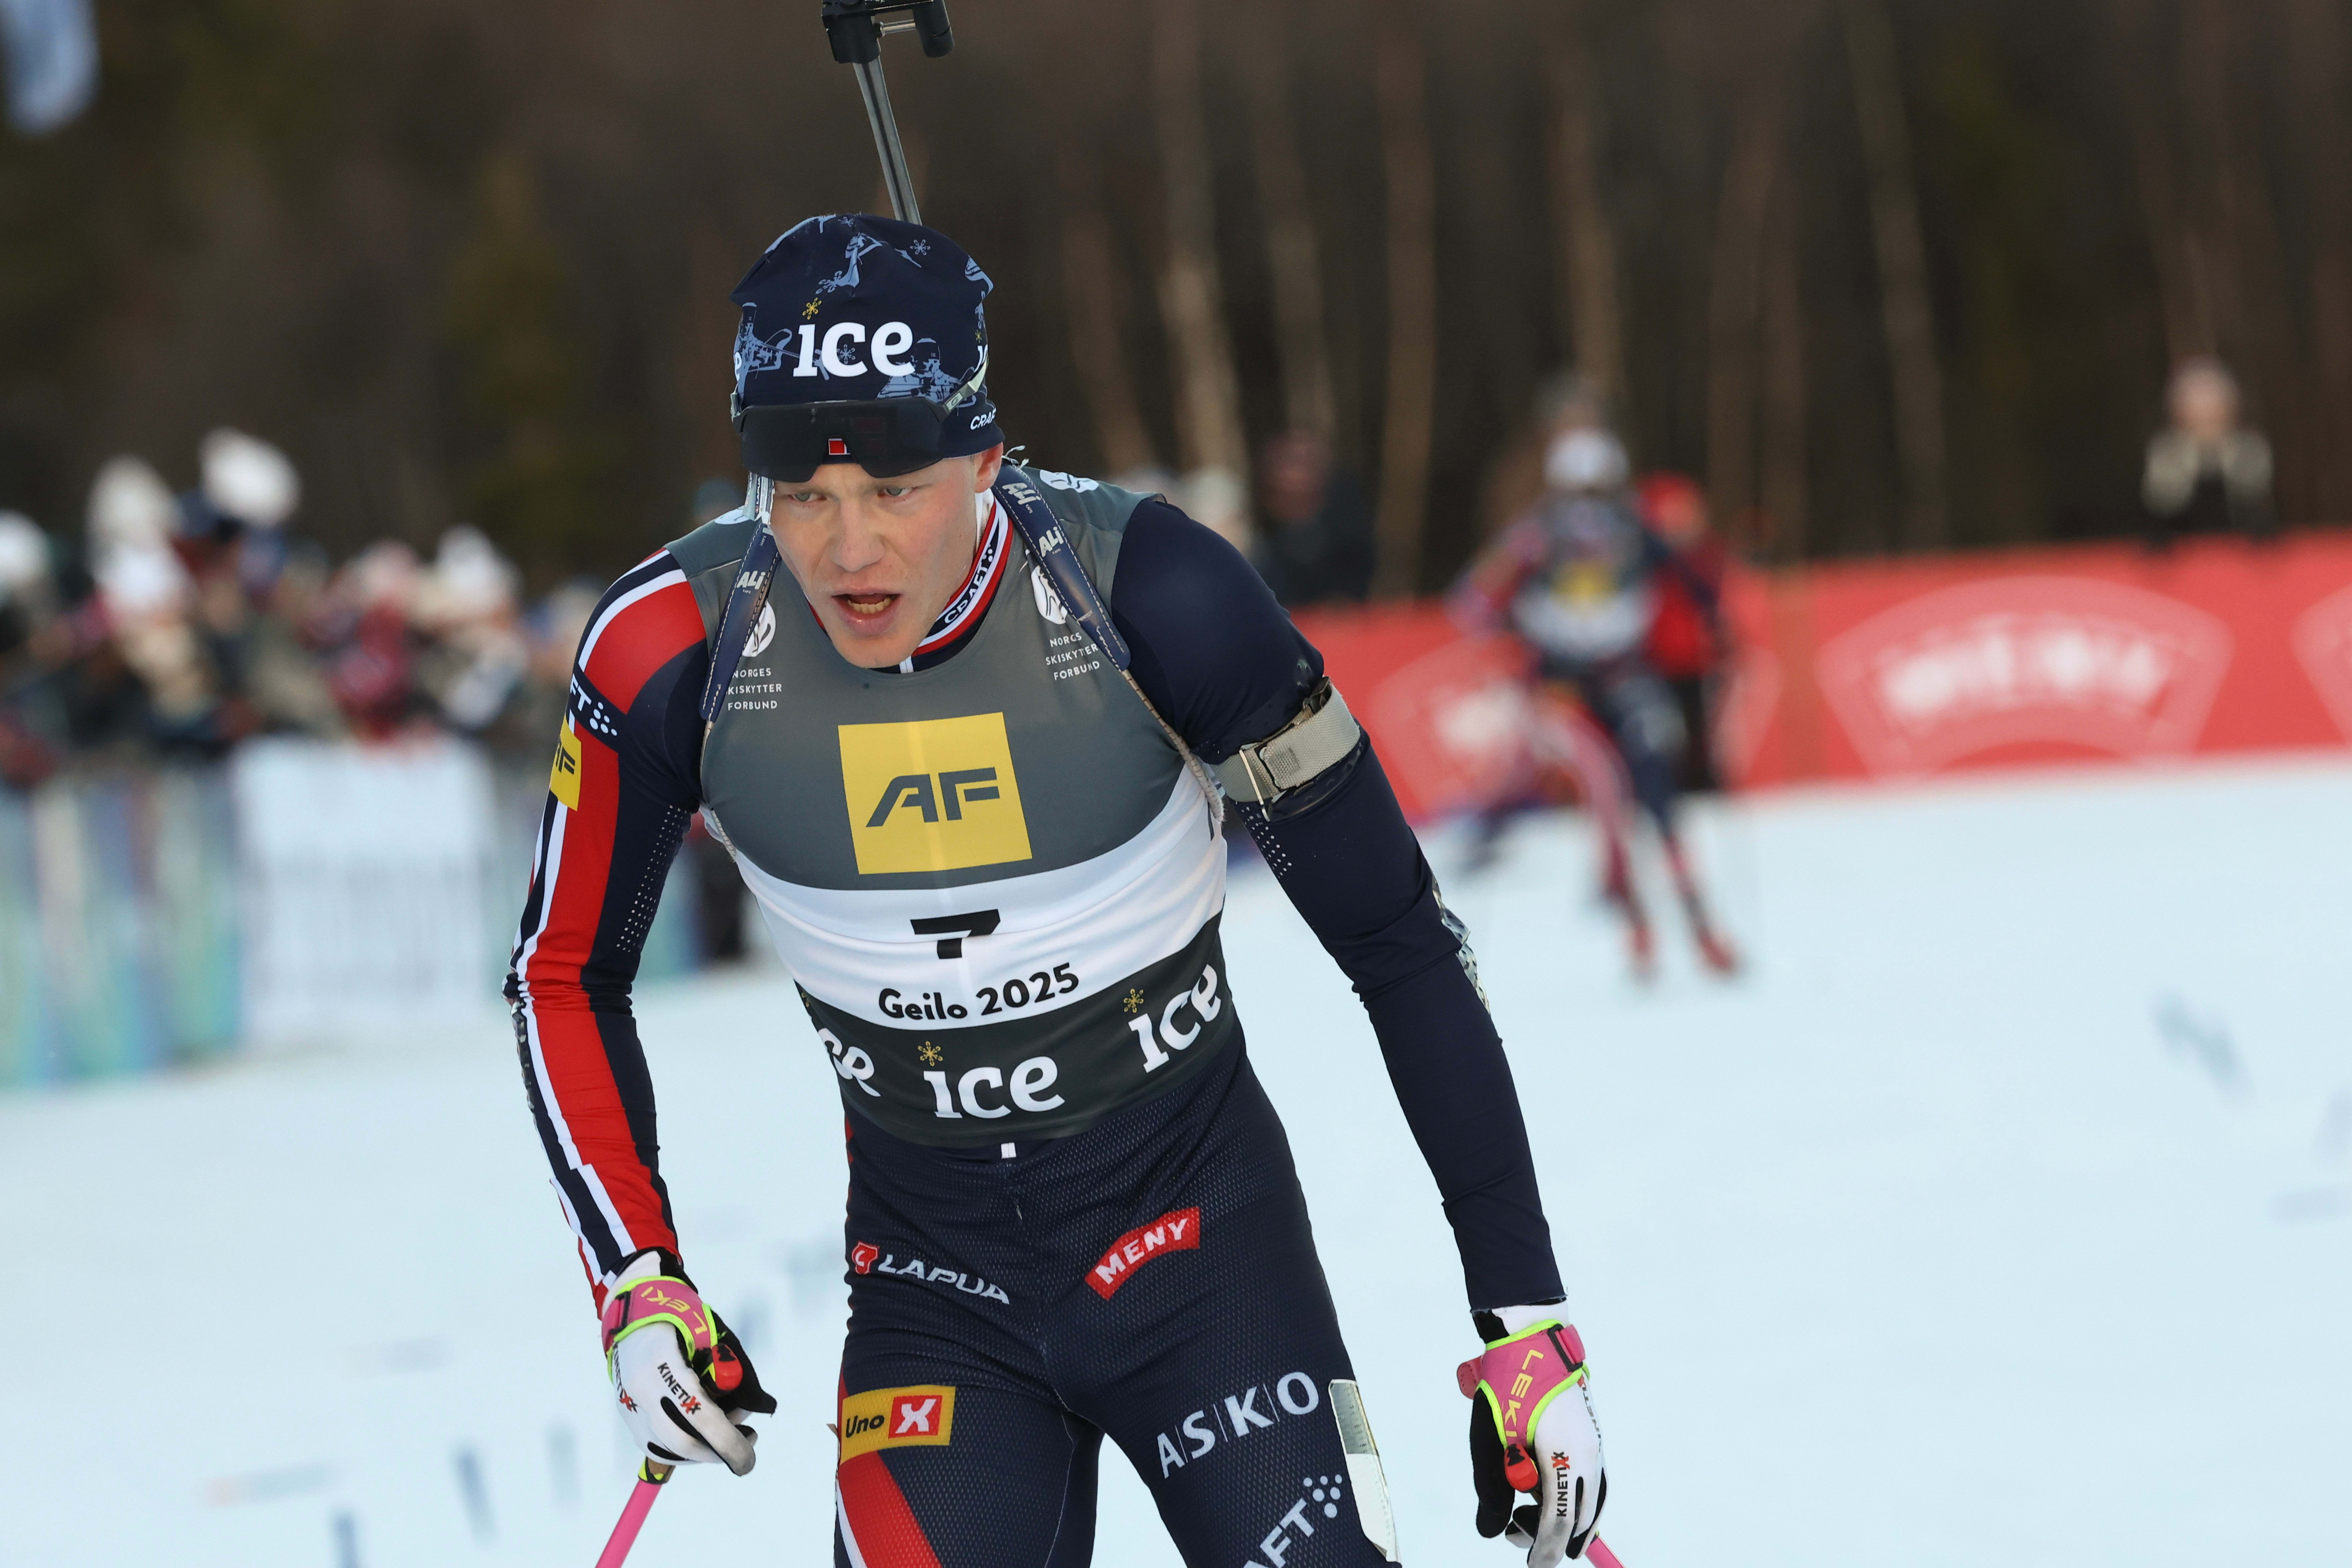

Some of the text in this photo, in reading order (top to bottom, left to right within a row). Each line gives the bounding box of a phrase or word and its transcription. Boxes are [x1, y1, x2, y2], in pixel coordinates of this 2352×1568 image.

[726, 683, 782, 695] KISKYTTER
[1053, 661, 1100, 681] FORBUND
[728, 700, 778, 711] FORBUND
[865, 767, 1000, 827] AF
[910, 909, 1000, 959] 7
[878, 962, 1080, 1020] Geilo 2025
[1095, 1218, 1189, 1285] MENY
[877, 1253, 1010, 1305] LAPUA
[640, 1286, 708, 1334] LEKI
[845, 1398, 937, 1439] Uno X
[1505, 1349, 1544, 1438] LEKI
